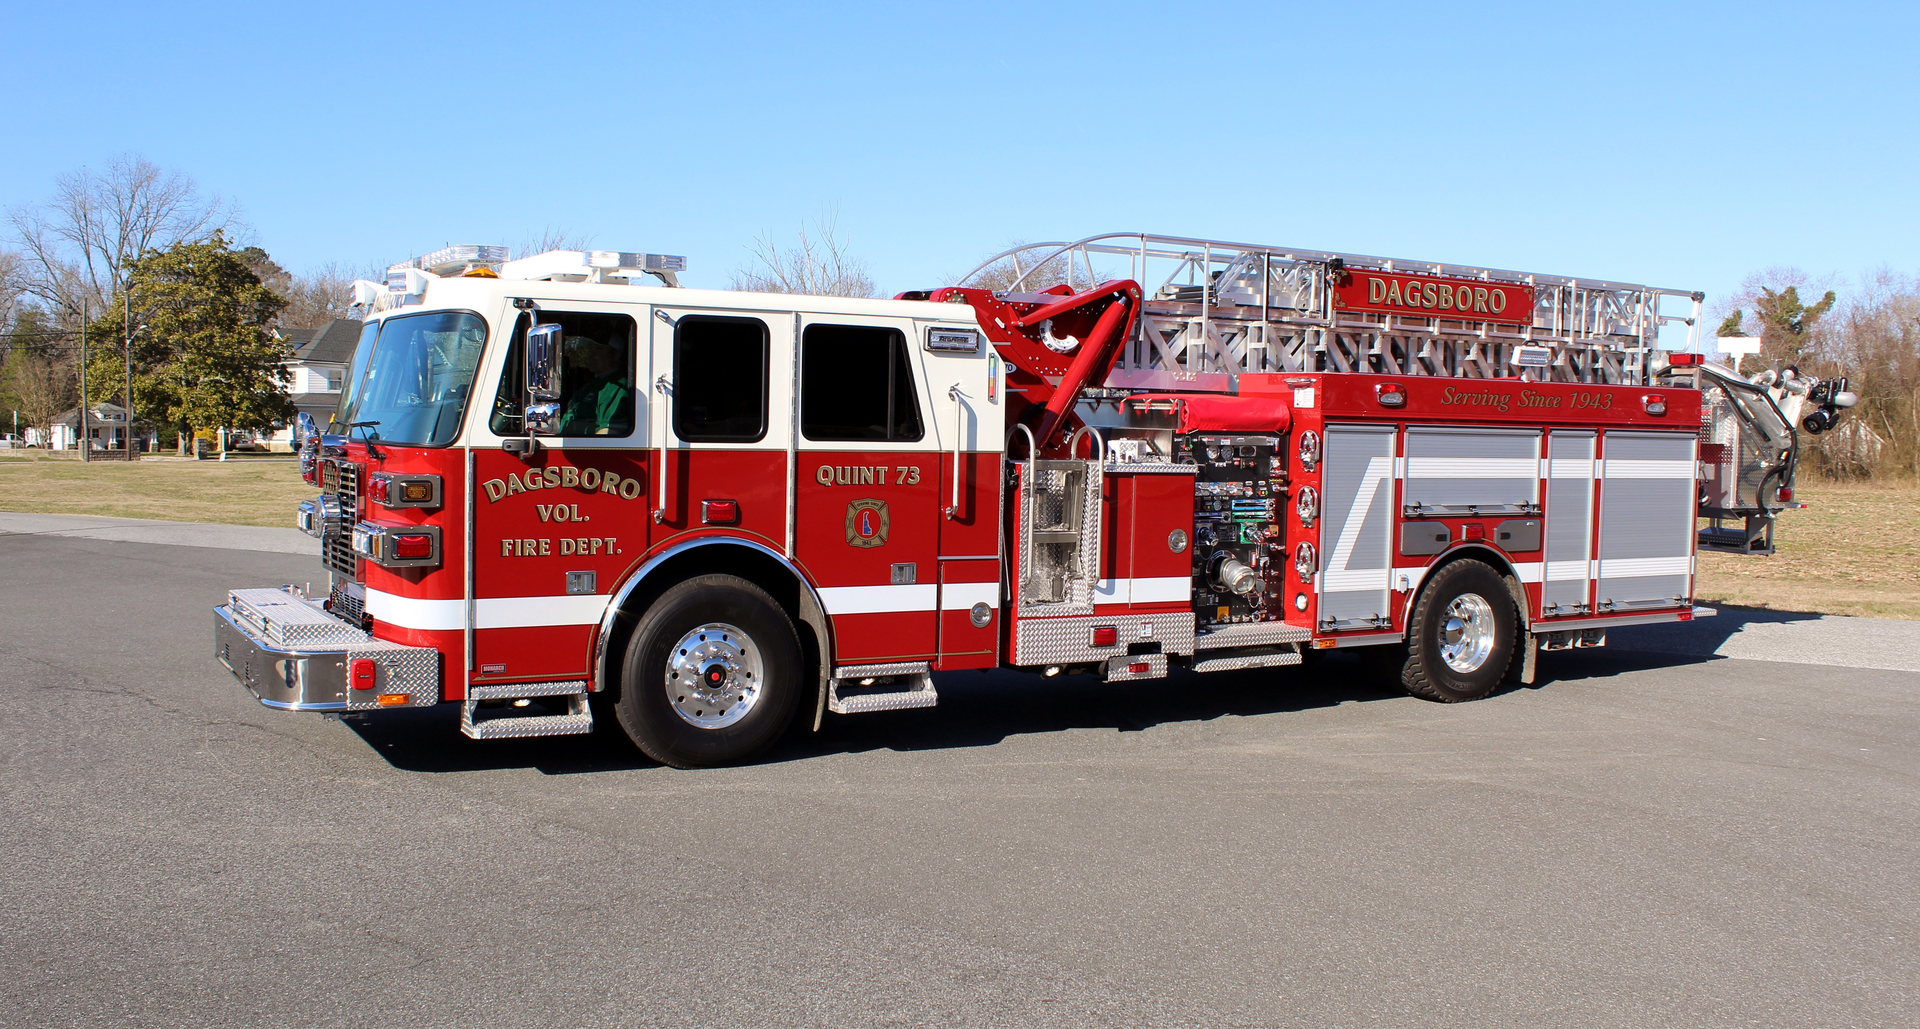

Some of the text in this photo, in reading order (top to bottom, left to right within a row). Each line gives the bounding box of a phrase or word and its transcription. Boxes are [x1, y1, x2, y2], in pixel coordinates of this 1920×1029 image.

[1368, 277, 1507, 314] DAGSBORO
[1440, 386, 1614, 413] Serving Since 1943
[482, 466, 641, 503] DAGSBORO
[816, 465, 921, 487] QUINT 73
[536, 503, 590, 523] VOL.
[501, 537, 623, 557] FIRE DEPT.
